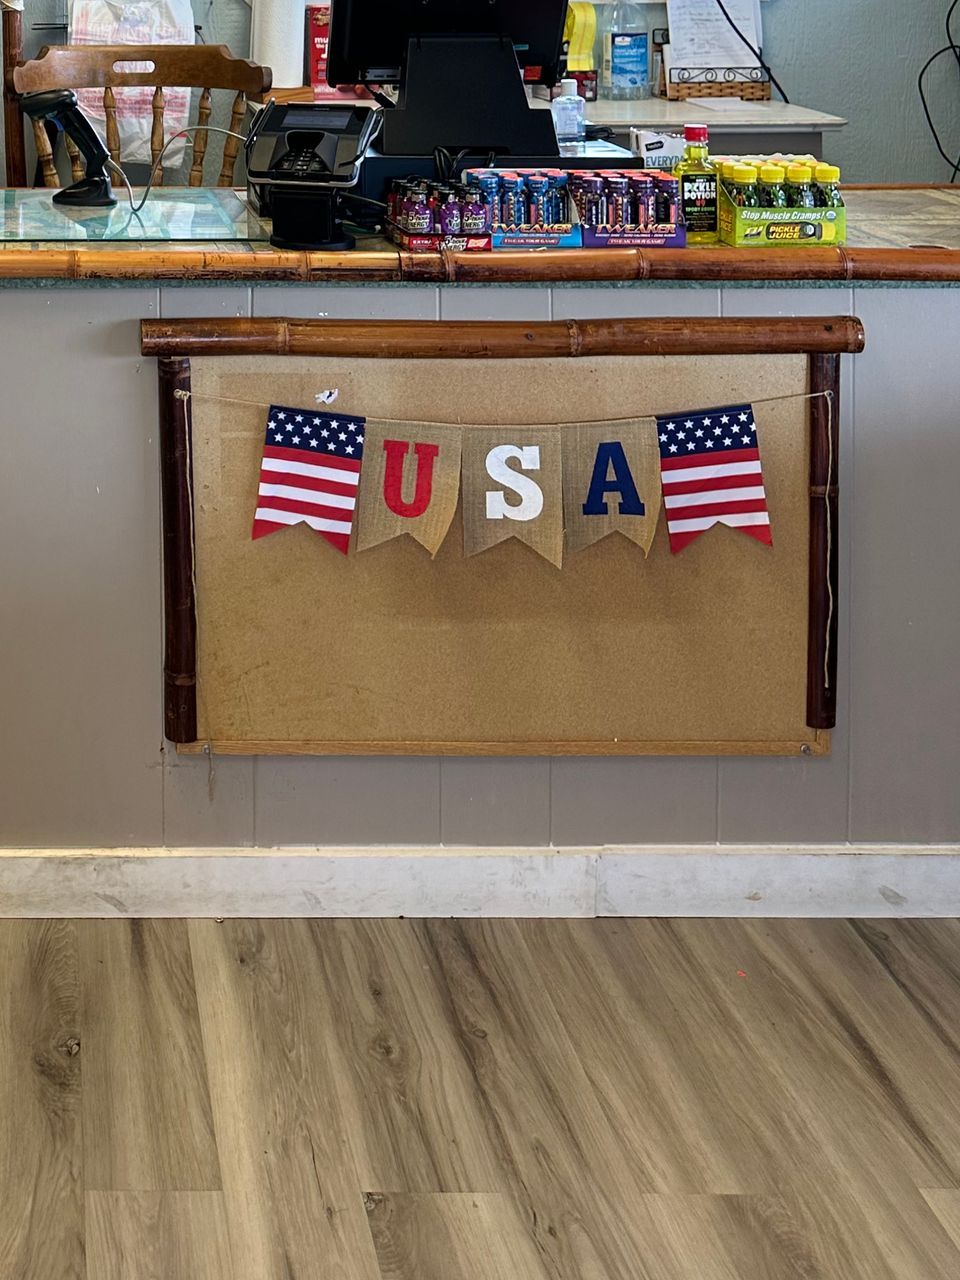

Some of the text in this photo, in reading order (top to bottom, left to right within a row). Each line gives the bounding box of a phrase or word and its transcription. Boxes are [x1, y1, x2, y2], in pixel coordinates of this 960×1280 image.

[684, 182, 716, 192] PICKLE
[684, 191, 716, 200] POTION
[463, 211, 486, 221] 5-hour
[741, 210, 825, 221] Stop Muscle Cramps!
[491, 223, 572, 233] TWEAKER
[596, 223, 676, 233] TWEAKER
[383, 439, 645, 521] U S A
